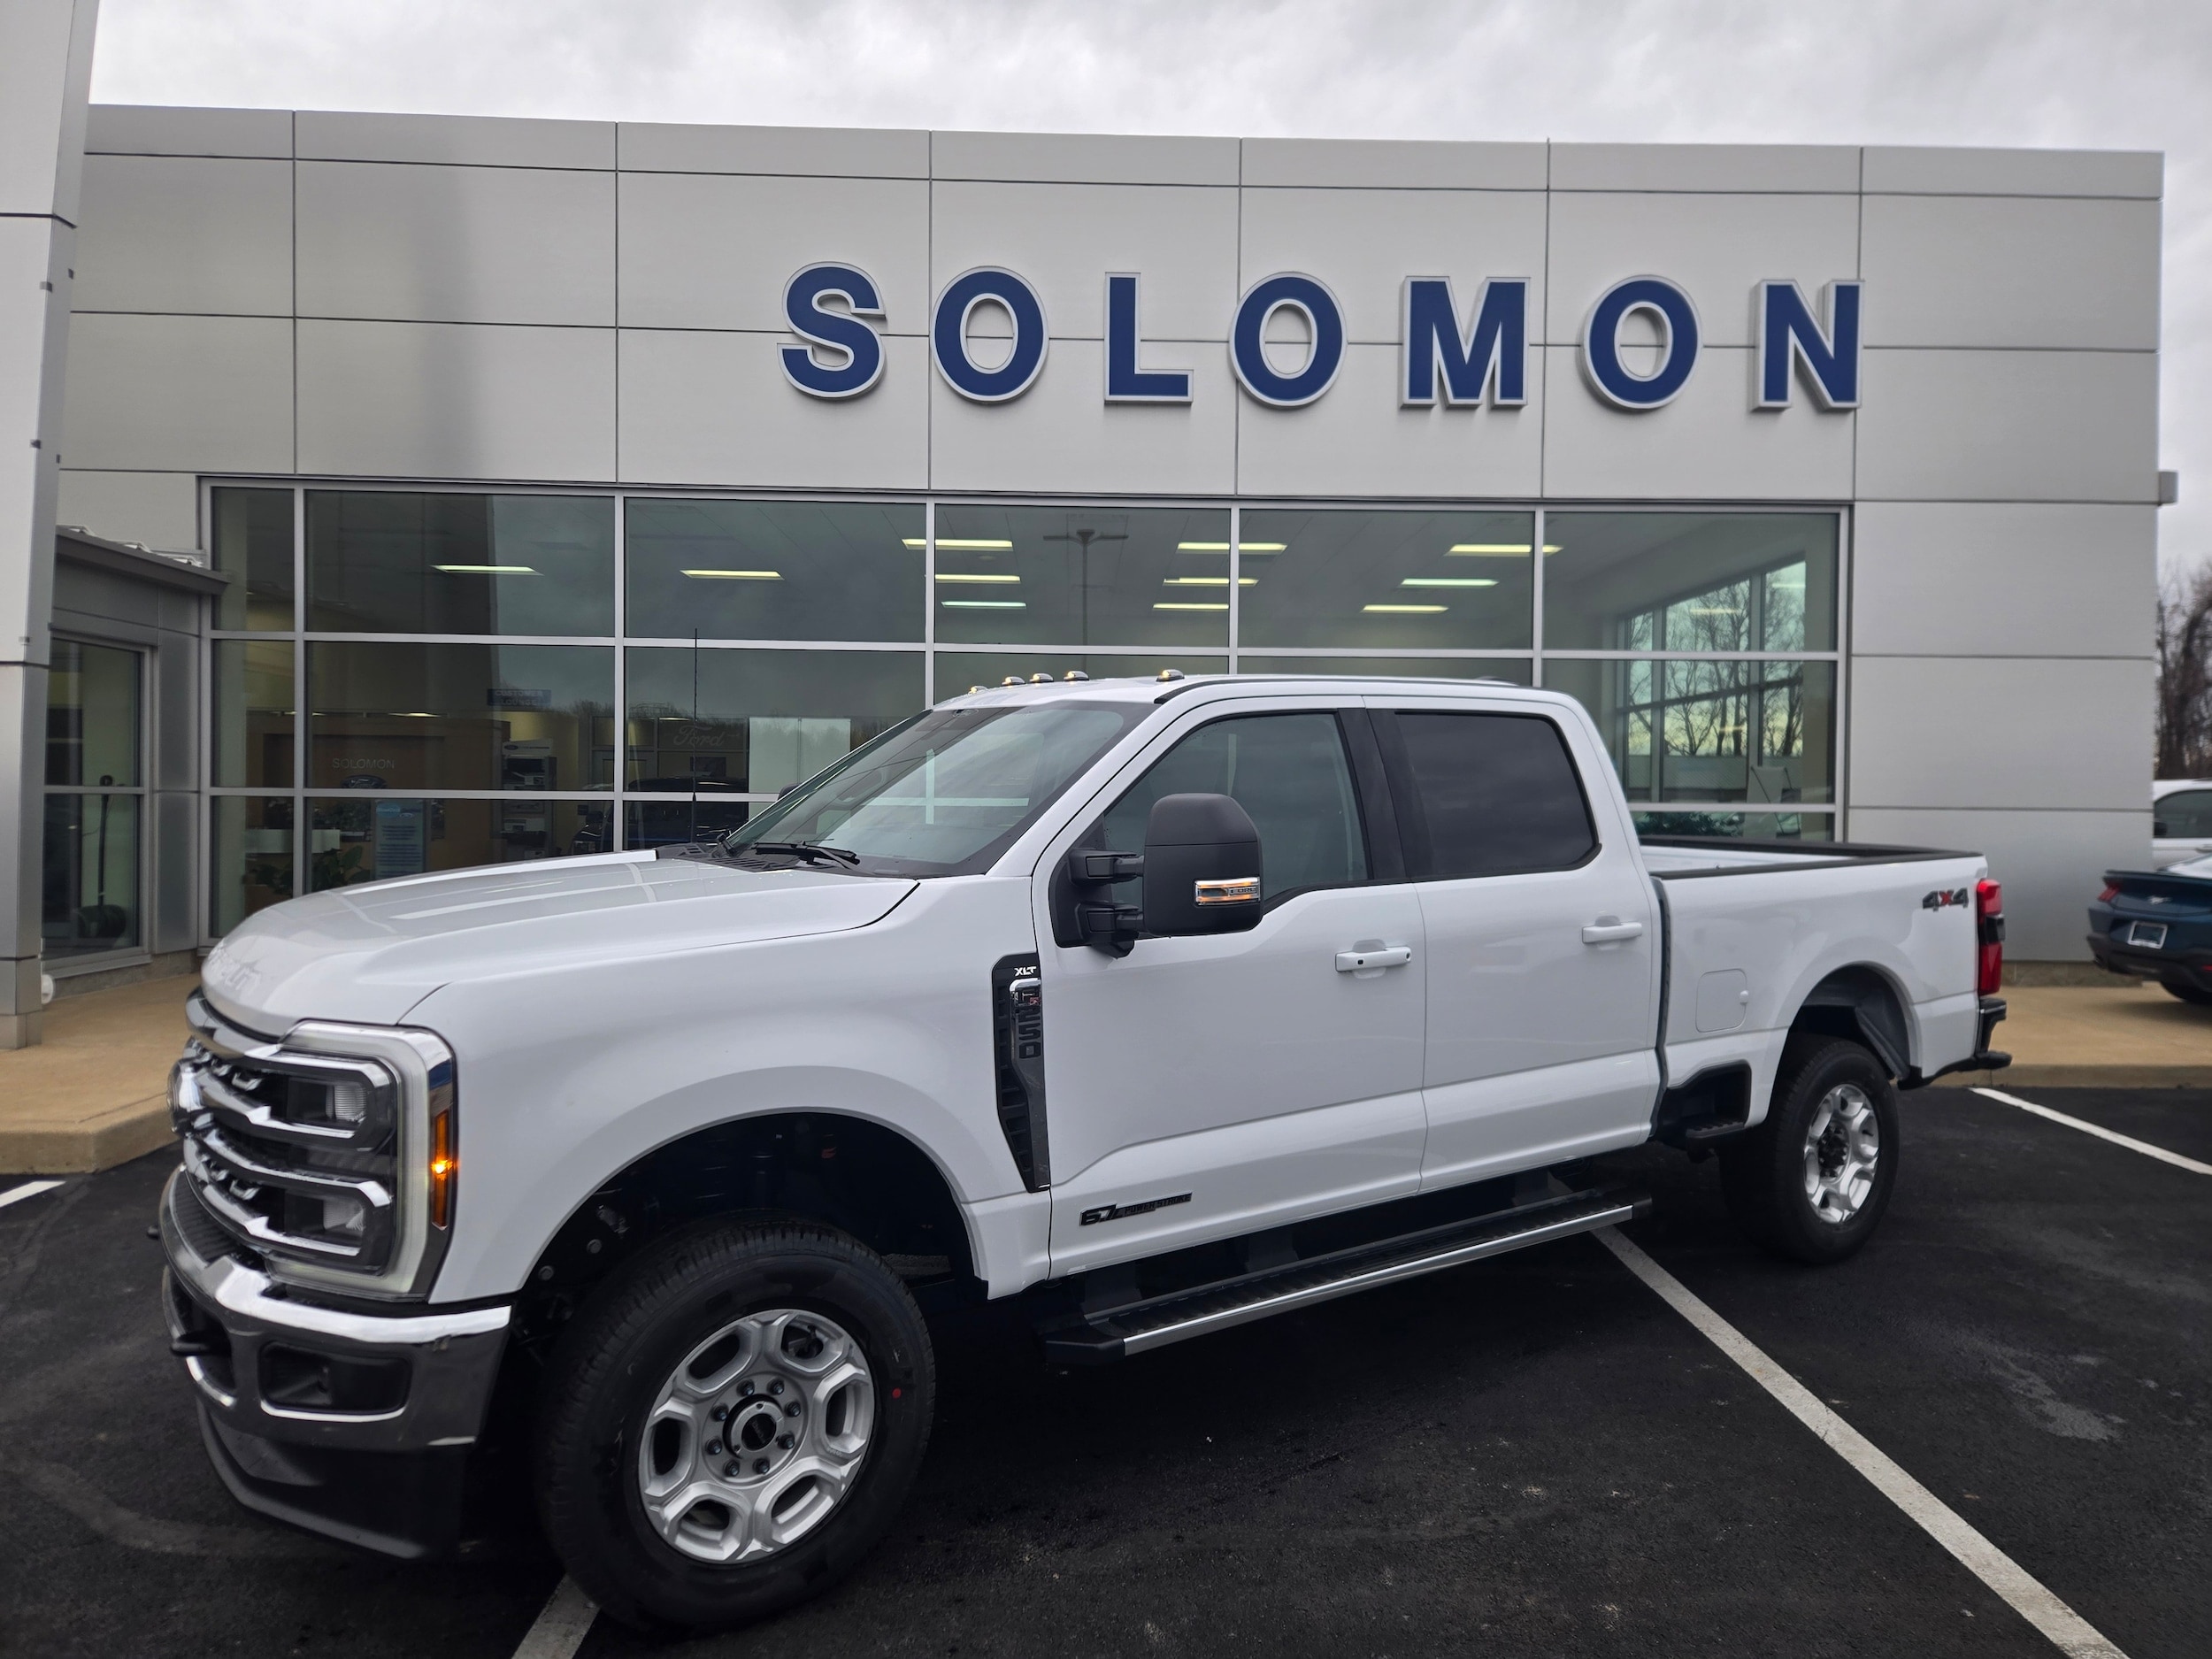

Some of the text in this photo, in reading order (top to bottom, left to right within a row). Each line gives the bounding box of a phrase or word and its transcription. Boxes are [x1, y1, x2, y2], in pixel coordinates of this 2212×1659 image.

[779, 262, 1864, 411] SOLOMON
[672, 725, 726, 747] Ford
[332, 757, 395, 769] SOLOMON
[1014, 965, 1037, 977] XLT
